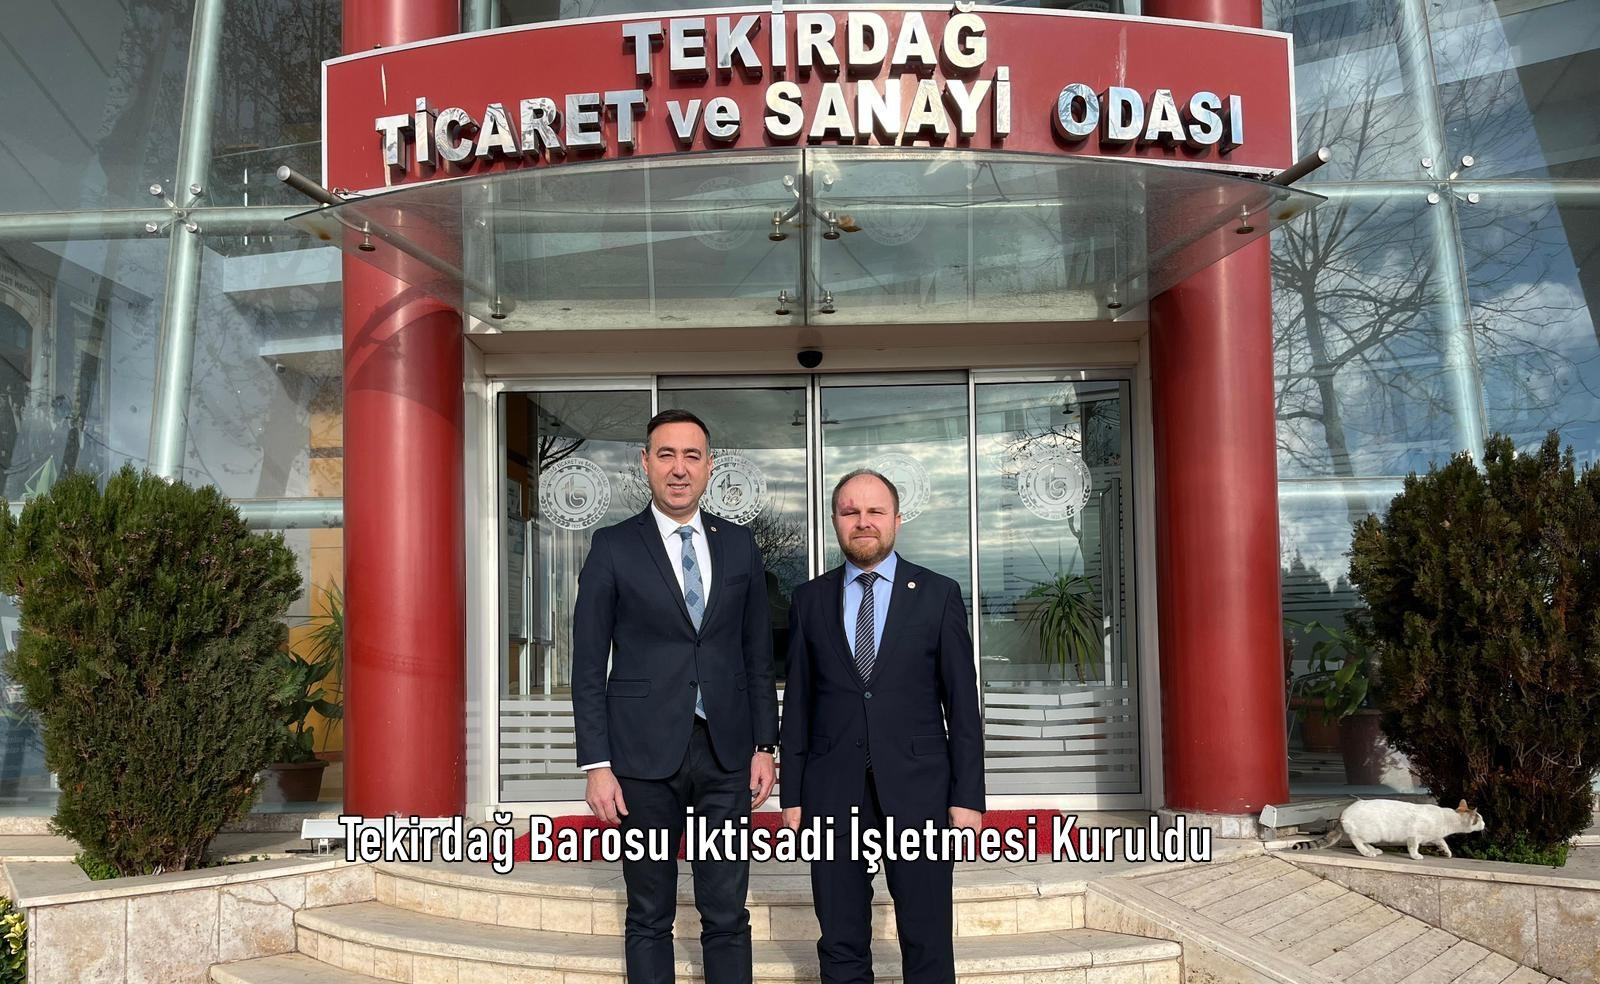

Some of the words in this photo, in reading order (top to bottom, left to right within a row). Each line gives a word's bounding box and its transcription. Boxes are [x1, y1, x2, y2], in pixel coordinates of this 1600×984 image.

[622, 0, 988, 78] TEKİRDAĞ
[375, 89, 645, 169] TİCARET
[666, 97, 741, 141] ve
[764, 66, 1011, 140] SANAYİ
[1056, 83, 1244, 147] ODASI
